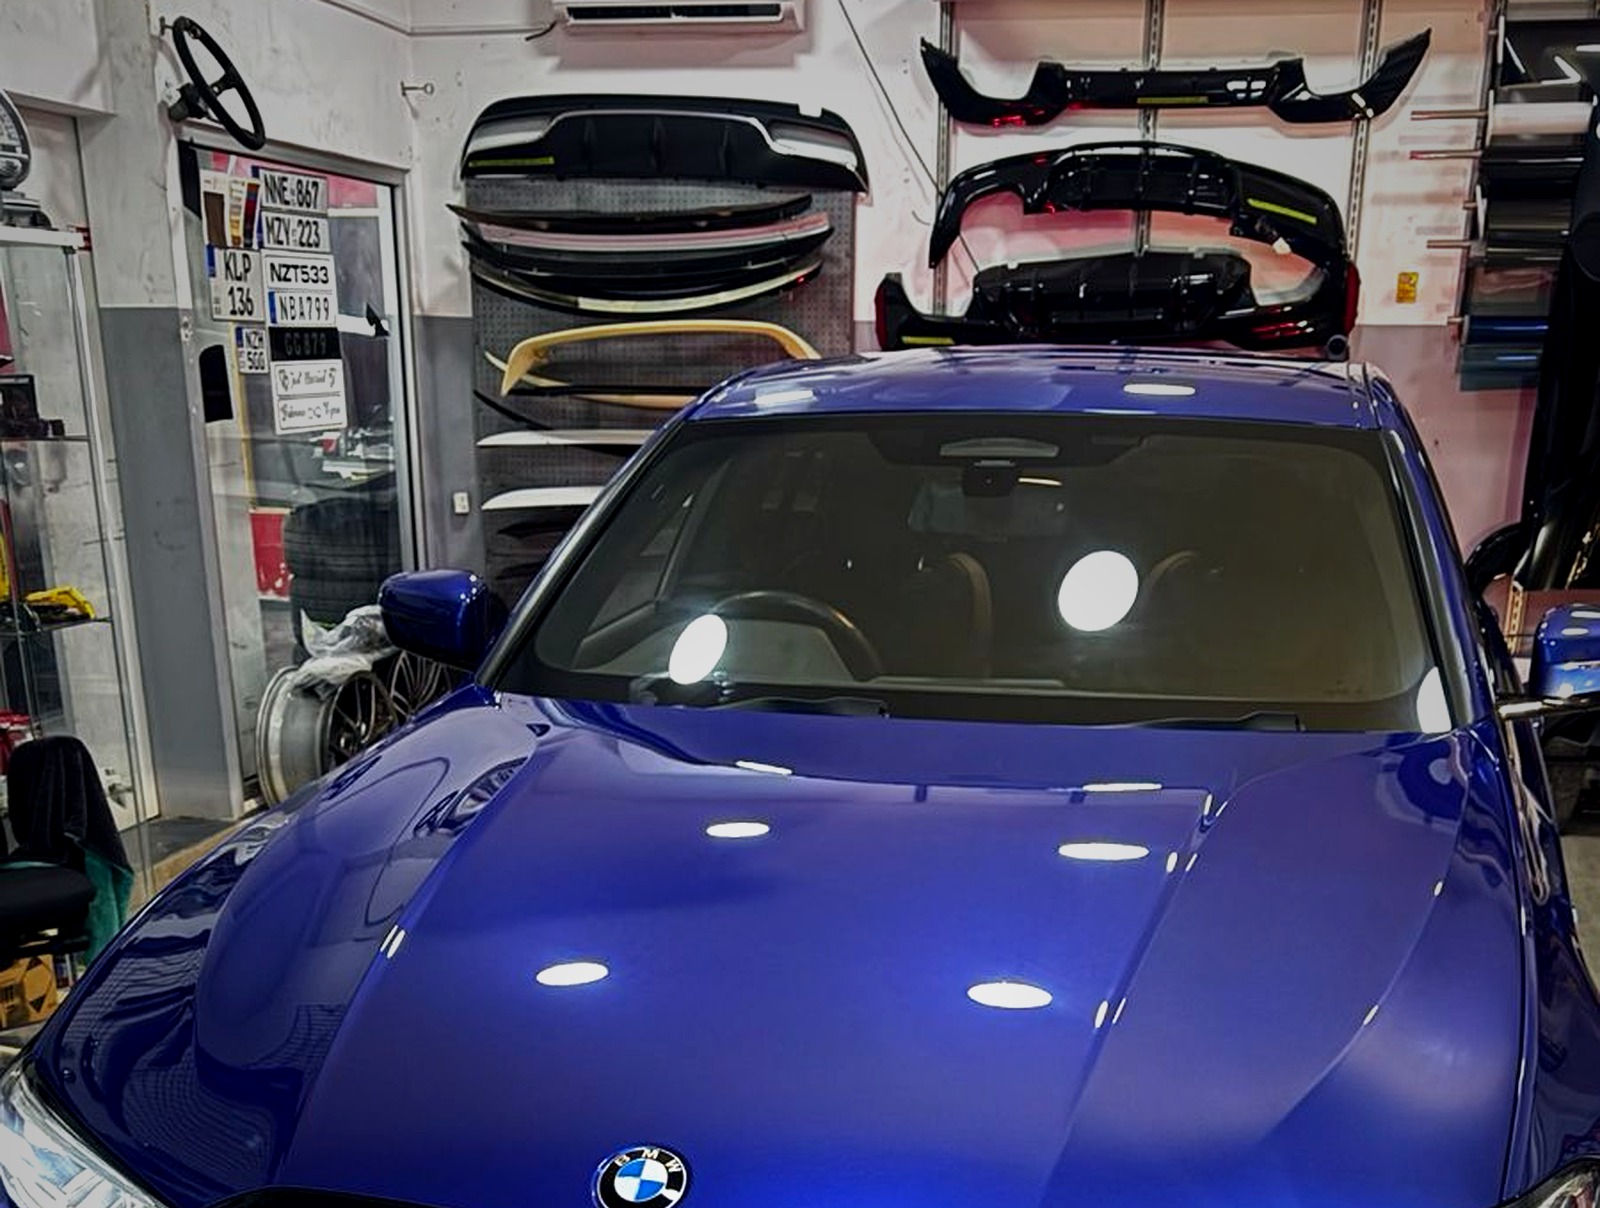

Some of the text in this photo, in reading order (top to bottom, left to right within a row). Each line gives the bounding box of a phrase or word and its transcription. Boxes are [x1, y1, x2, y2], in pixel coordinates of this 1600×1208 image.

[263, 173, 290, 206] NNE
[296, 178, 319, 209] 867
[264, 215, 290, 246] MZY
[297, 219, 320, 248] 223
[223, 251, 251, 282] KLP
[269, 262, 329, 285] NZT533
[227, 285, 254, 316] 136
[279, 295, 329, 321] NBA799
[613, 1147, 683, 1173] BMW
